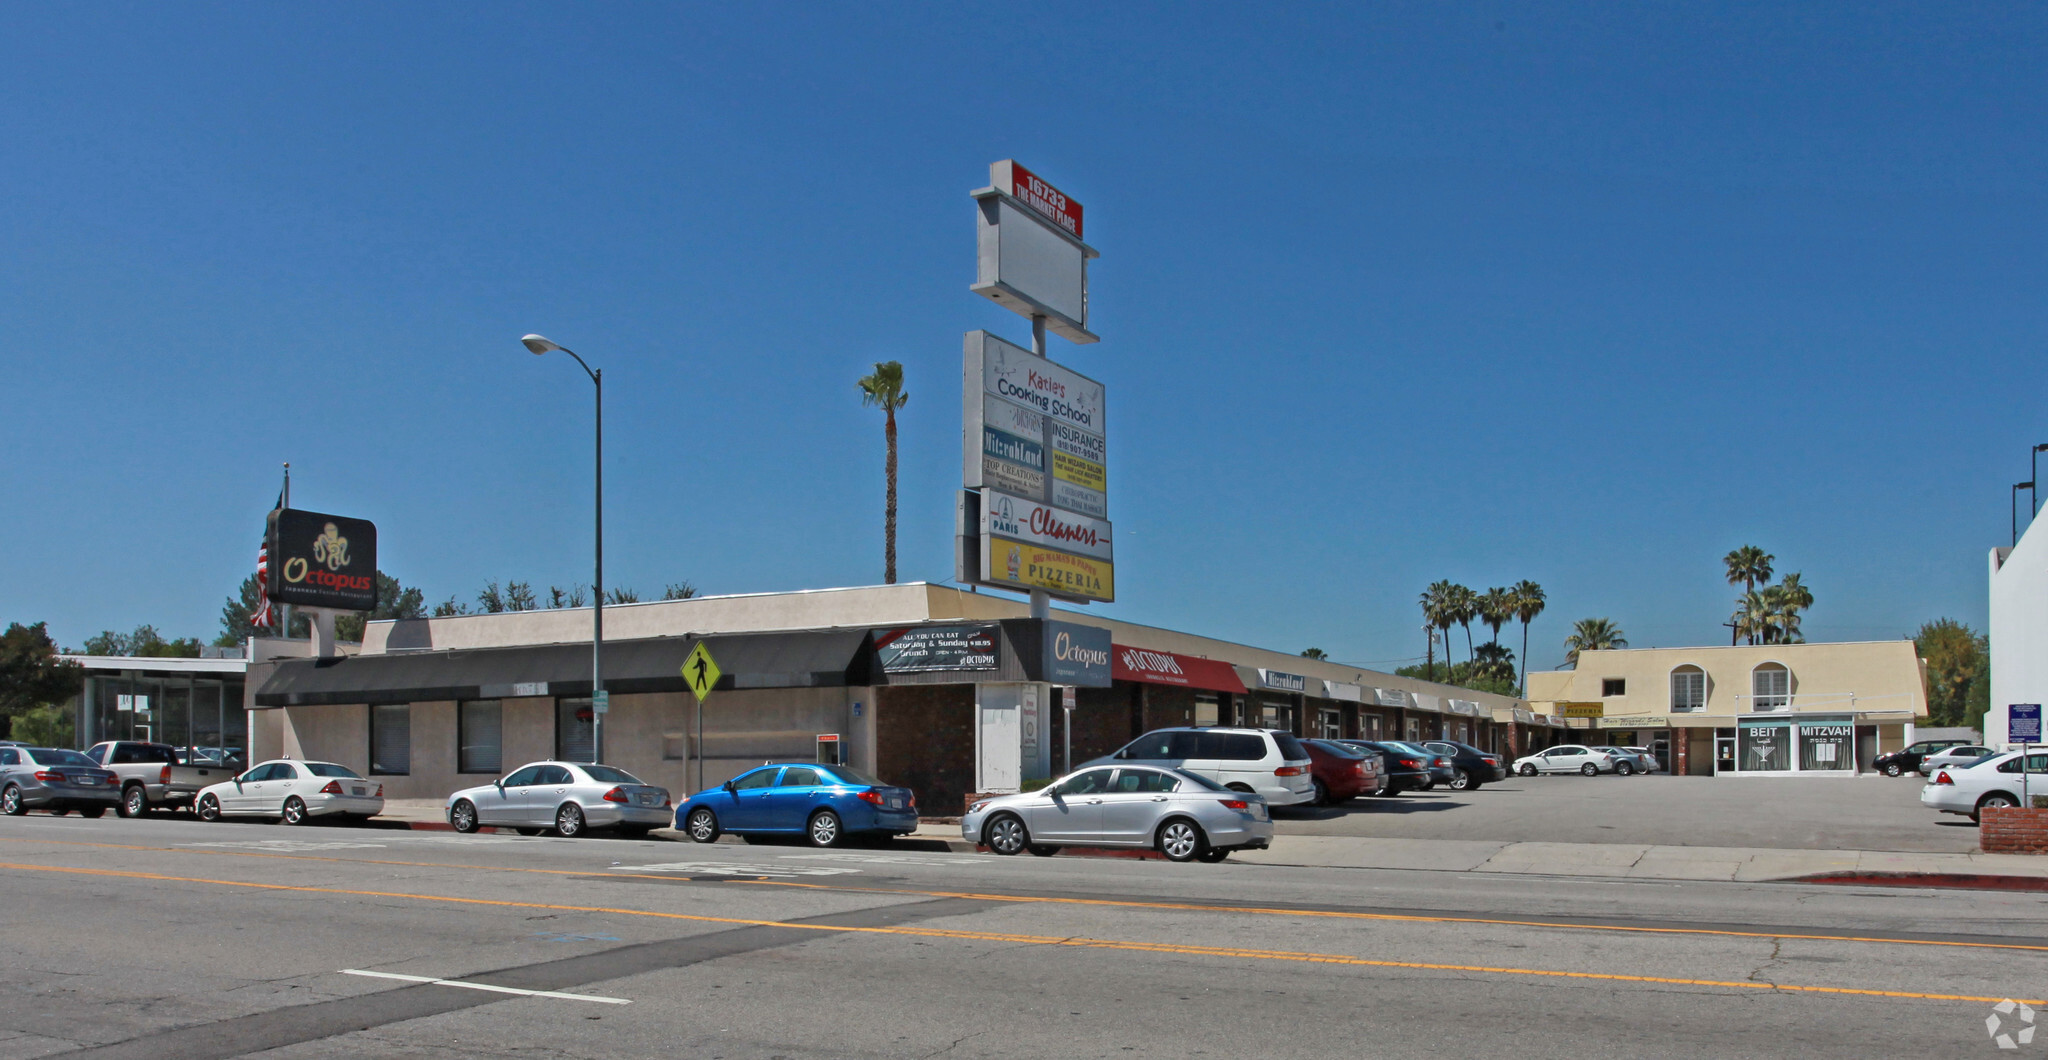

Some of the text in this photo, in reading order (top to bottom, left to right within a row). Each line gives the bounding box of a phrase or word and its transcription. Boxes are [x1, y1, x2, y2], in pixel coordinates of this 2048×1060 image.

[1027, 176, 1066, 212] 16733
[1016, 183, 1076, 233] THE MARKET PLACE
[1028, 368, 1066, 398] Katie's
[998, 378, 1049, 411] Cooking
[1051, 400, 1091, 427] School
[1052, 423, 1104, 453] INSURANCE
[986, 459, 1040, 482] TOP CREATIONS
[1067, 457, 1086, 470] WIZARD
[993, 519, 1019, 534] PARIS
[1030, 507, 1097, 547] Cleaners
[1033, 553, 1045, 564] BIG
[283, 557, 371, 591] Octopus
[1029, 563, 1101, 590] PIZZERIA
[285, 586, 317, 594] Japanese
[903, 633, 914, 641] ALL
[938, 639, 969, 648] Sunday
[966, 655, 995, 664] OCTOPUS
[1055, 631, 1107, 669] Octopus
[1129, 649, 1184, 675] OCTOPUS
[1749, 727, 1778, 737] BEIT
[1800, 726, 1851, 736] MITZVAH
